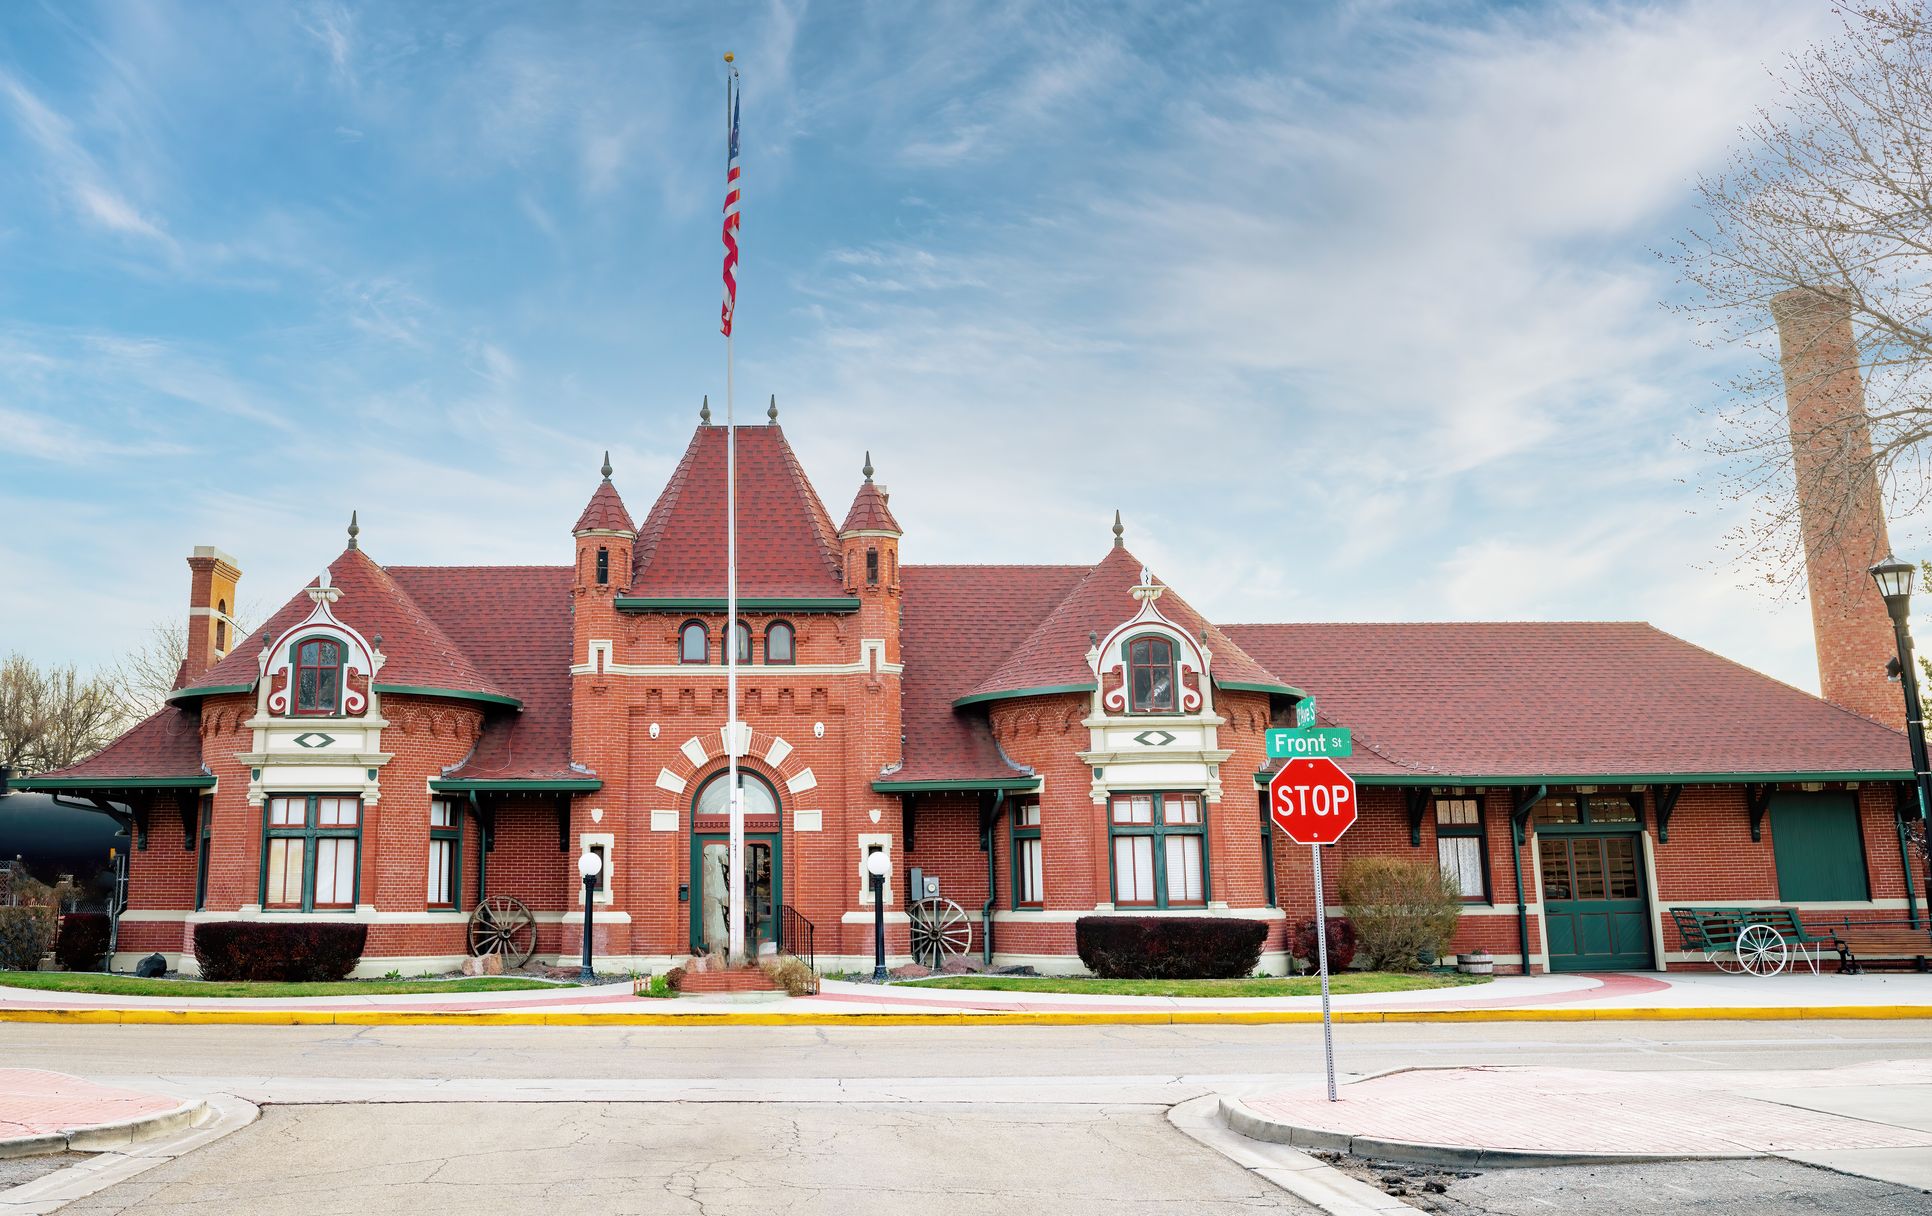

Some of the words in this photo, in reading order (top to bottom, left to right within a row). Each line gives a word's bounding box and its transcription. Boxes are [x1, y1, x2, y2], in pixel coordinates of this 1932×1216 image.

[1275, 734, 1326, 752] Front
[1332, 738, 1342, 748] St
[1277, 785, 1349, 817] STOP
